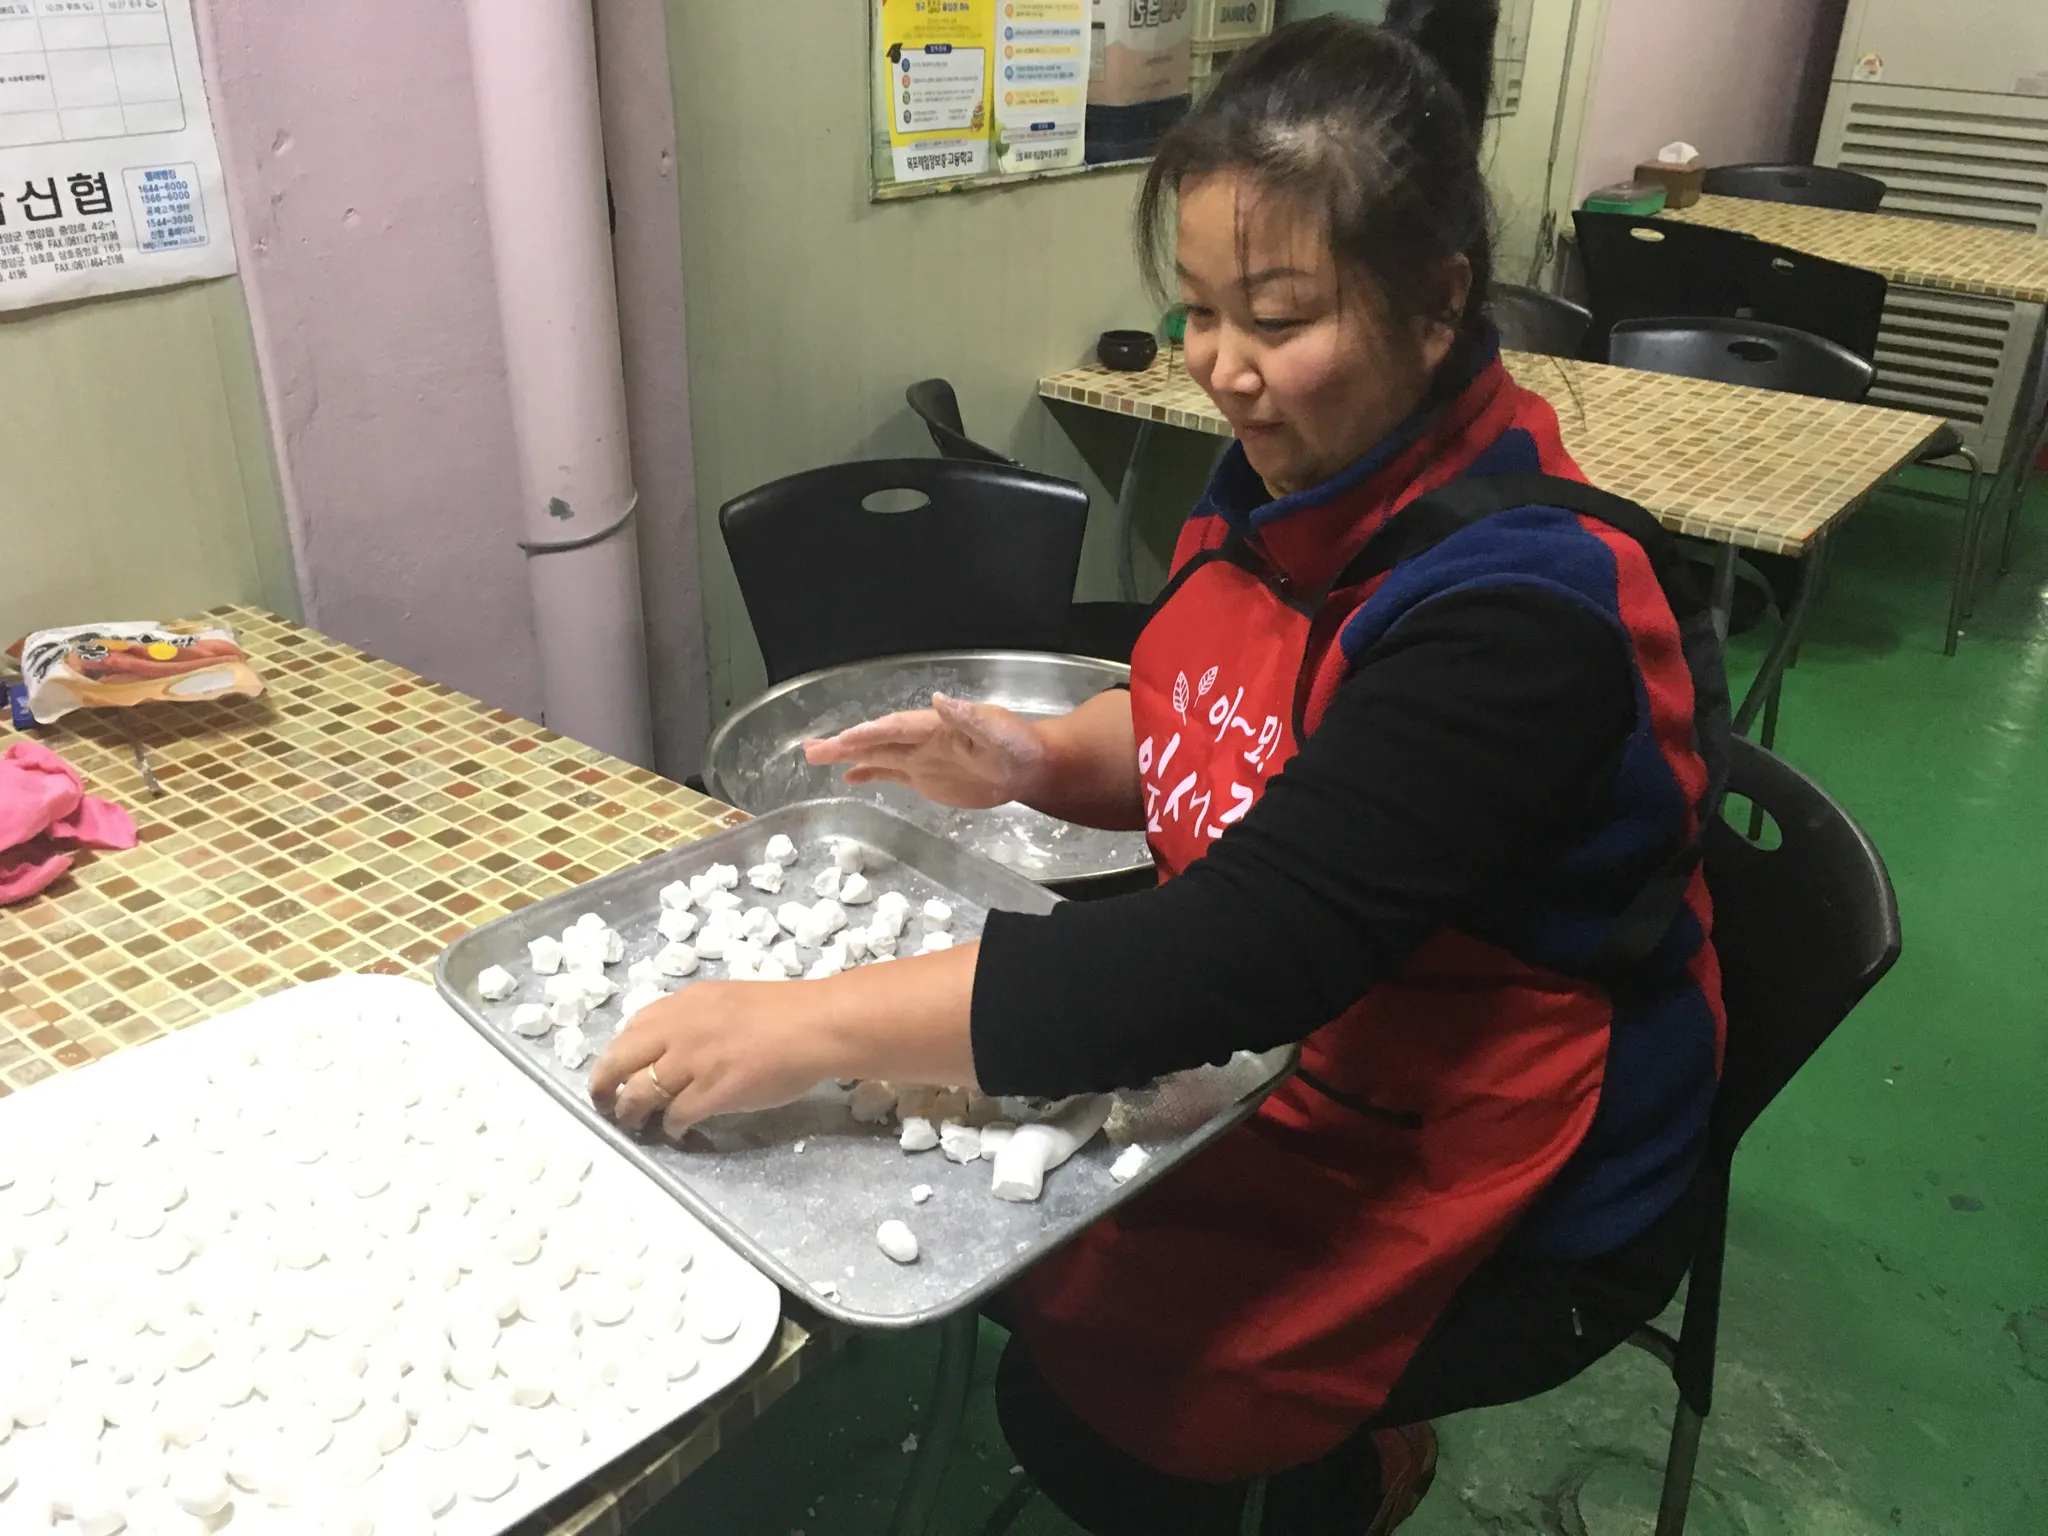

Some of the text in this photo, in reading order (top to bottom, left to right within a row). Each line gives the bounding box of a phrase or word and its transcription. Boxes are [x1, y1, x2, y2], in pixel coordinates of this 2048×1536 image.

[138, 180, 189, 194] 1644-6000
[0, 171, 113, 226] 신협
[141, 190, 191, 204] 1566-6000
[91, 219, 117, 231] 42-1
[146, 213, 194, 228] 1544-3030
